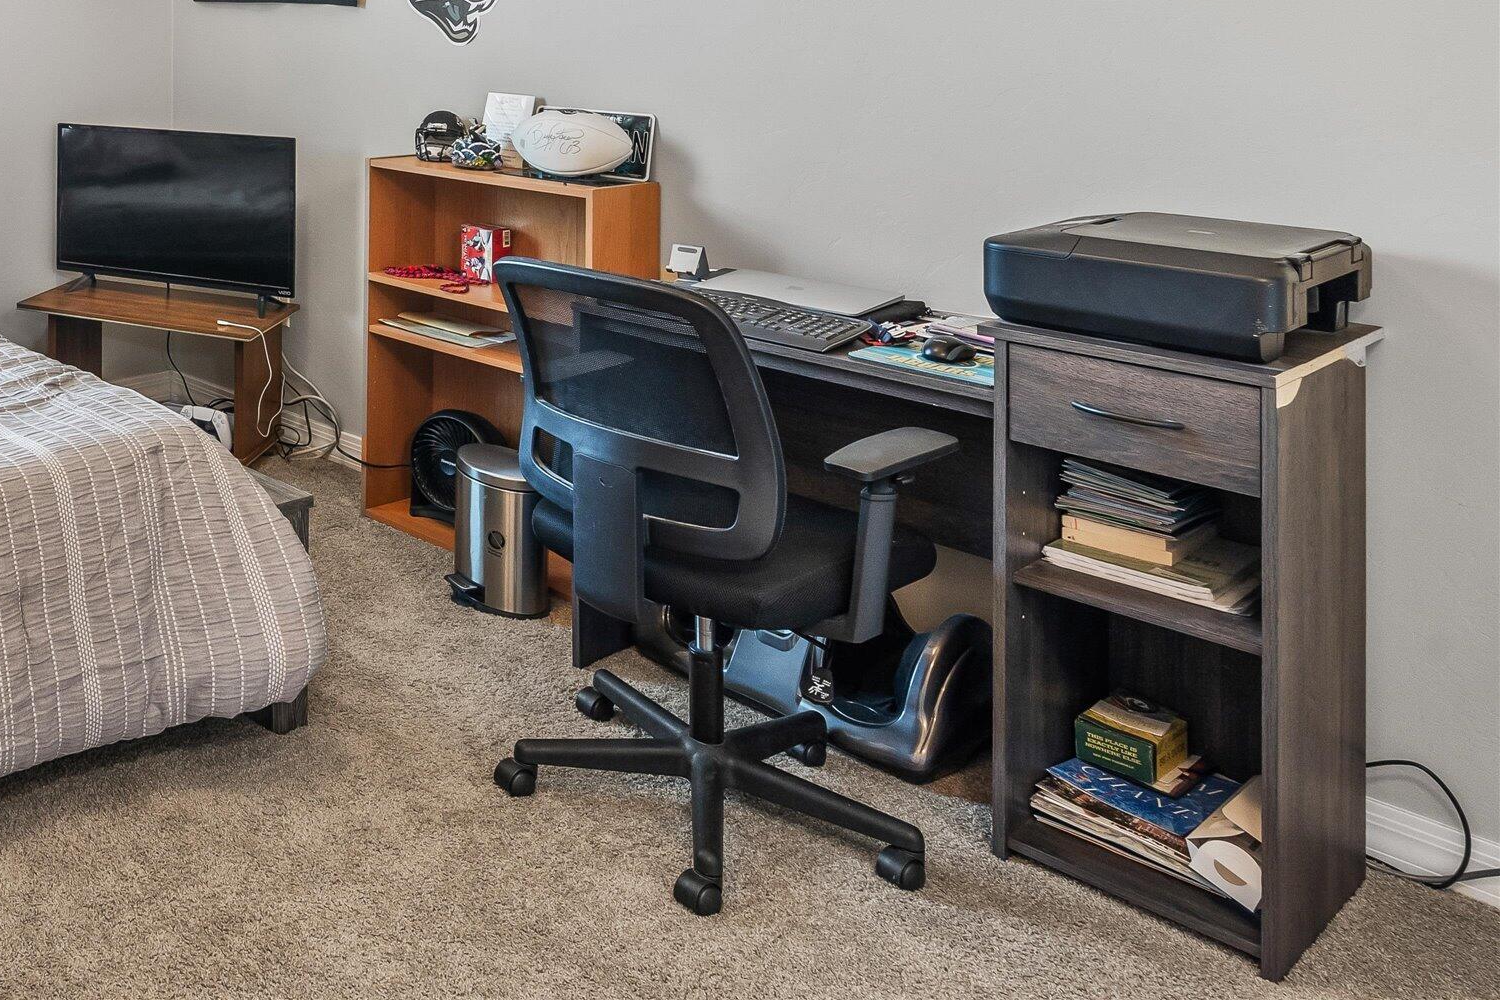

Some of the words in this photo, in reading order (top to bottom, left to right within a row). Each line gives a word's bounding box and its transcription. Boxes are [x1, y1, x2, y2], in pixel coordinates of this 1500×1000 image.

[1085, 742, 1122, 758] NOWHERE
[1087, 737, 1120, 752] EXACTLY
[1120, 748, 1138, 759] LIKE
[1104, 737, 1128, 751] PLACE
